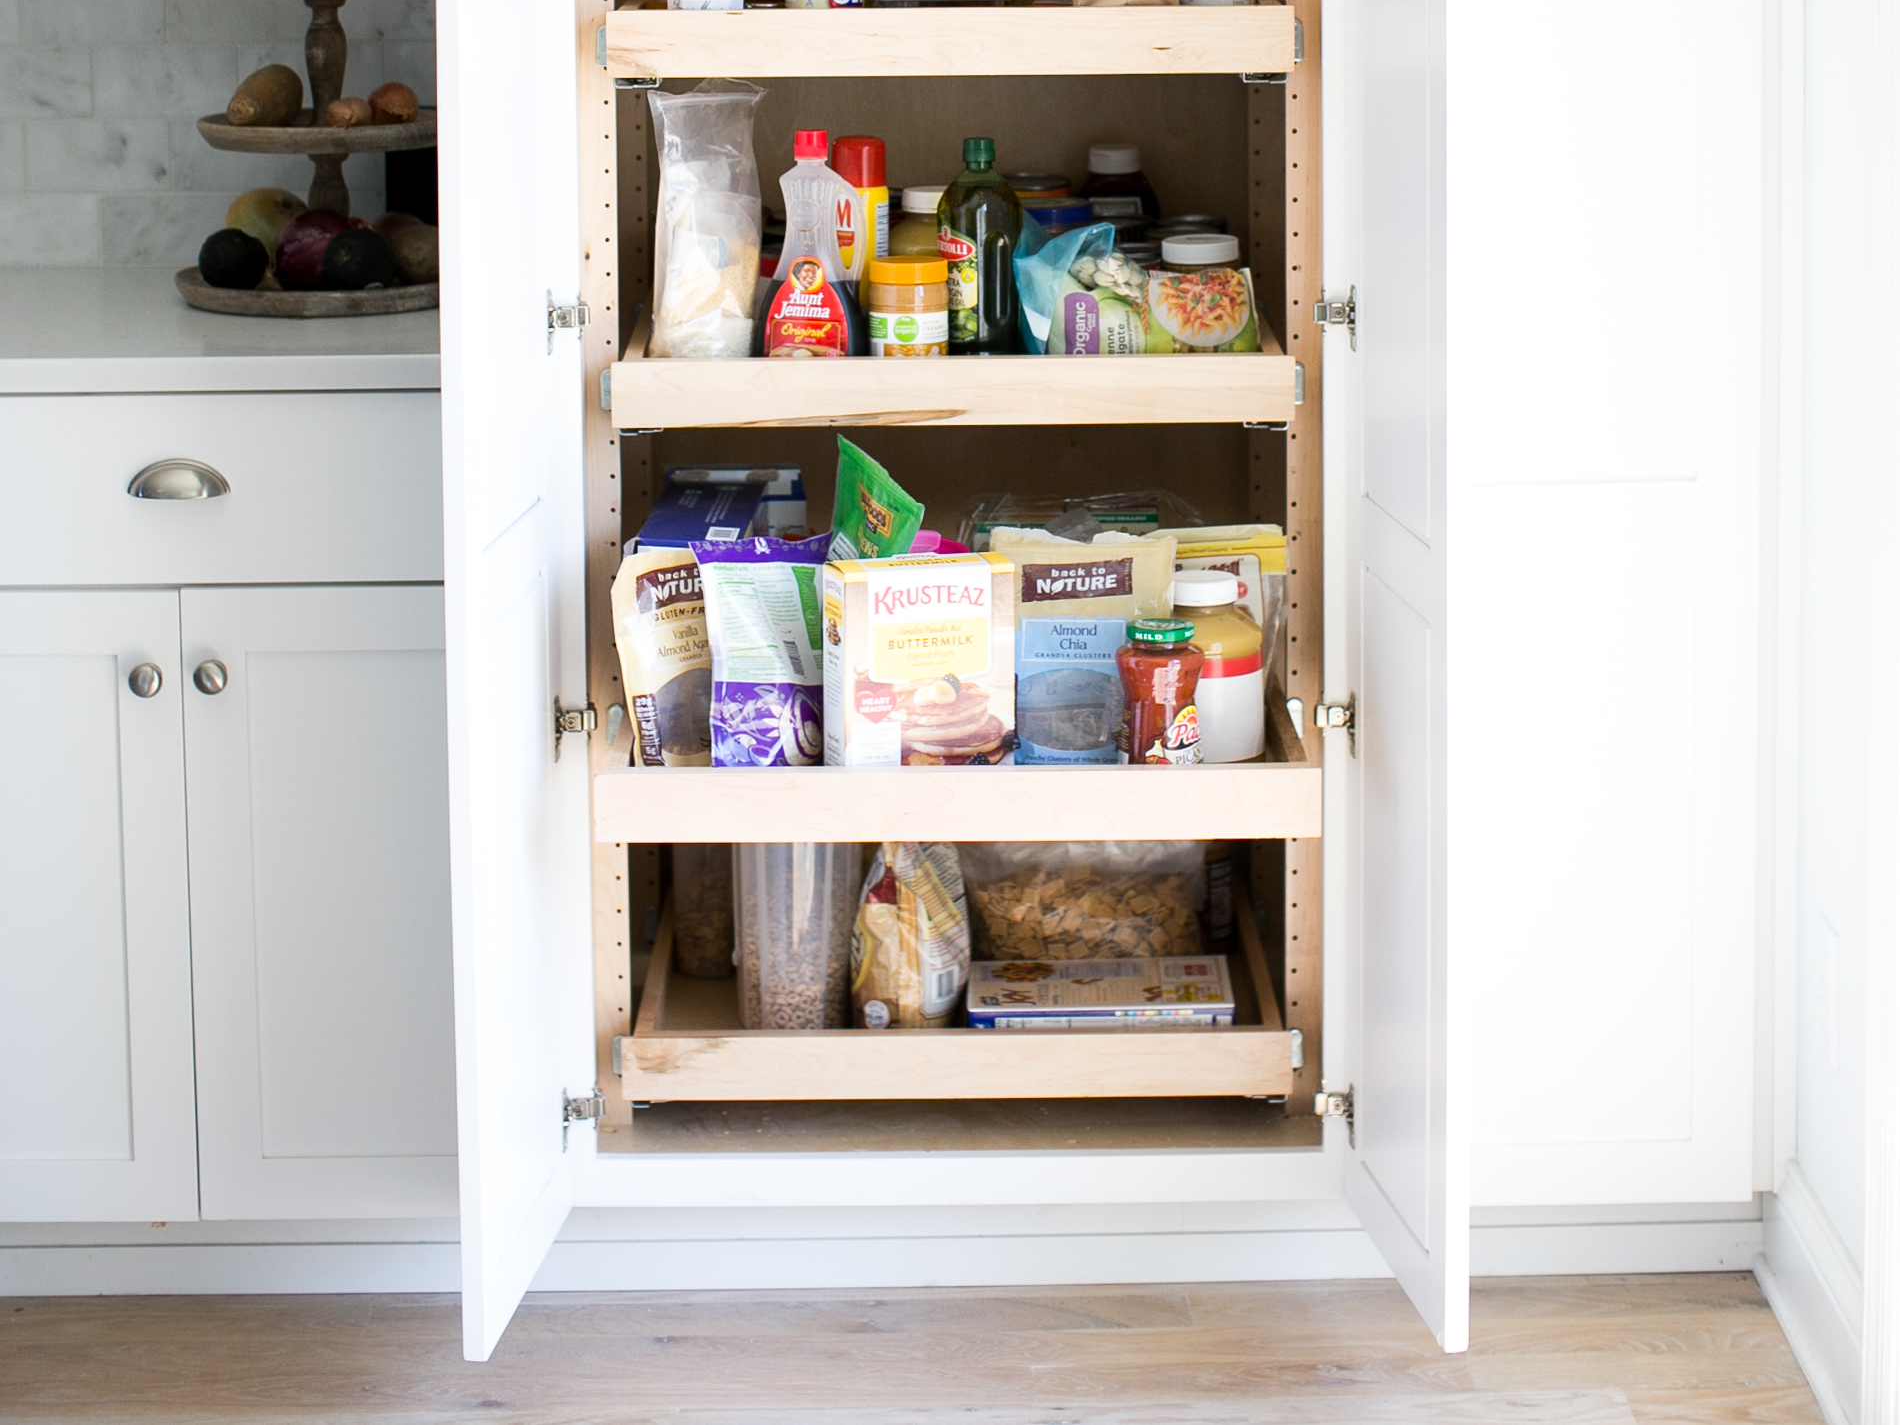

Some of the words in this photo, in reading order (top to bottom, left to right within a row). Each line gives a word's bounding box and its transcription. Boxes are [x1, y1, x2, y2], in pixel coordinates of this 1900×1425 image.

[938, 241, 968, 255] ERTOLLI
[788, 289, 824, 305] Aunt
[774, 301, 830, 319] Jemima
[781, 323, 832, 343] Original
[1073, 301, 1090, 355] Organic
[1107, 327, 1115, 354] enne
[1118, 323, 1128, 354] igate
[888, 559, 958, 567] BUTTERMILK
[658, 569, 688, 583] back
[1052, 569, 1086, 578] back
[1092, 567, 1106, 575] to
[1036, 574, 1118, 595] NATURE
[874, 584, 986, 616] KRUSTEAZ
[654, 606, 706, 622] GLUTEN-FR
[672, 625, 699, 640] Vanilla
[898, 626, 924, 637] Complete
[926, 625, 949, 634] Pancake
[950, 623, 962, 633] Mix
[1050, 625, 1098, 637] Almond
[1135, 633, 1164, 641] MILD
[658, 641, 691, 658] Almond
[888, 635, 974, 651] BUTTERMILK
[1060, 639, 1088, 651] Chia
[679, 653, 703, 663] GRANOLA
[907, 651, 925, 661] Light
[934, 649, 956, 660] Fluffy
[862, 697, 890, 706] HEART
[859, 705, 893, 713] HEALTHY
